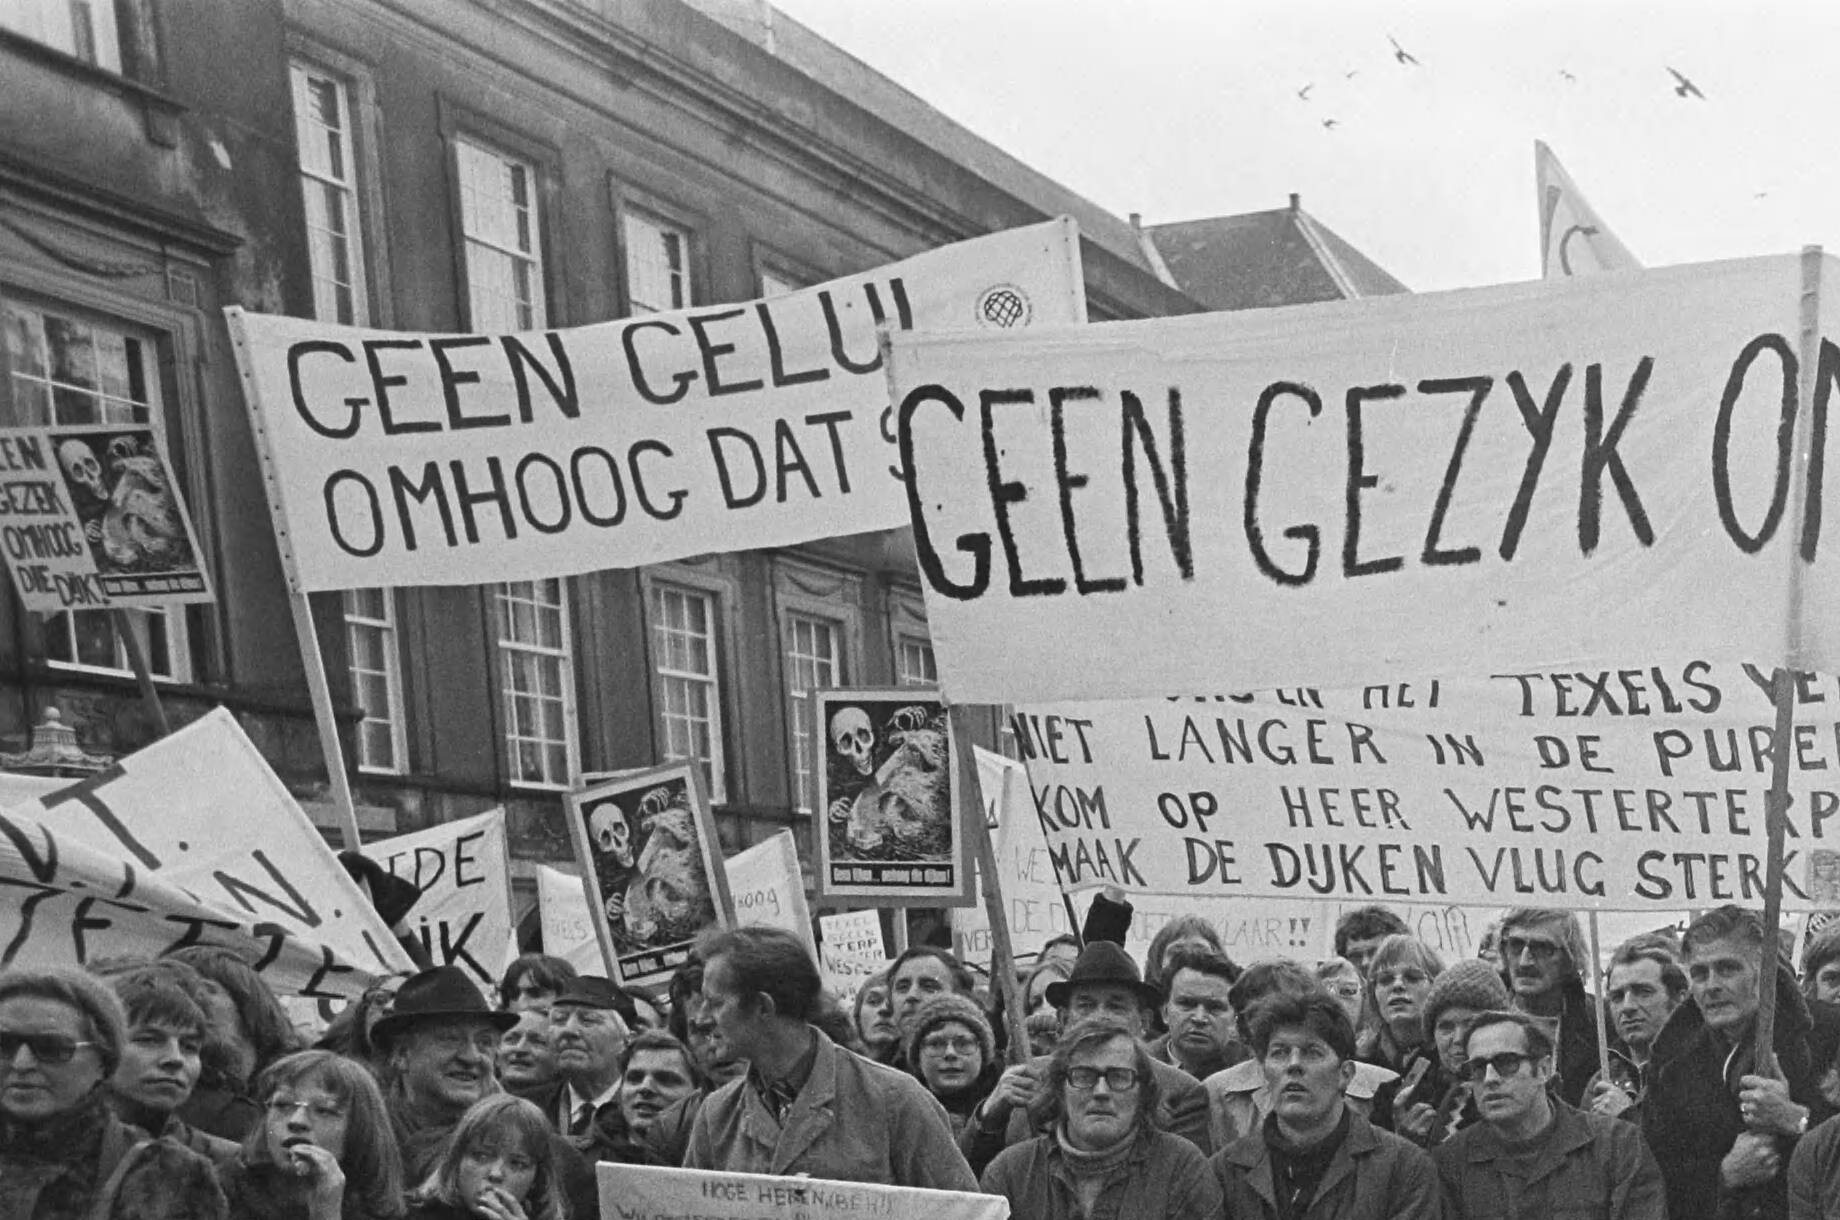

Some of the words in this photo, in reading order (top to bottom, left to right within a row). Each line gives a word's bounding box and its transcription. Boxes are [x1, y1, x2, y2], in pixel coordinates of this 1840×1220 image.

[288, 332, 581, 439] GEEN
[323, 439, 689, 557] OMHOOG
[709, 410, 853, 510] DAT
[898, 384, 1194, 600] GEEN
[1244, 356, 1655, 586] GEZYK
[1491, 661, 1722, 716] TEXELS
[1010, 713, 1092, 764] NIET
[1144, 715, 1386, 764] LANGER
[1427, 734, 1484, 766] IN
[1534, 735, 1613, 773] DE
[1033, 785, 1110, 832] KOM
[1157, 791, 1218, 832] OP
[1281, 785, 1411, 830] HEER
[1444, 786, 1839, 838] WESTERTERP
[1049, 838, 1147, 887] MAAK
[1184, 837, 1241, 885] DE
[1466, 847, 1605, 894] VLUG
[1635, 850, 1810, 900] STERK
